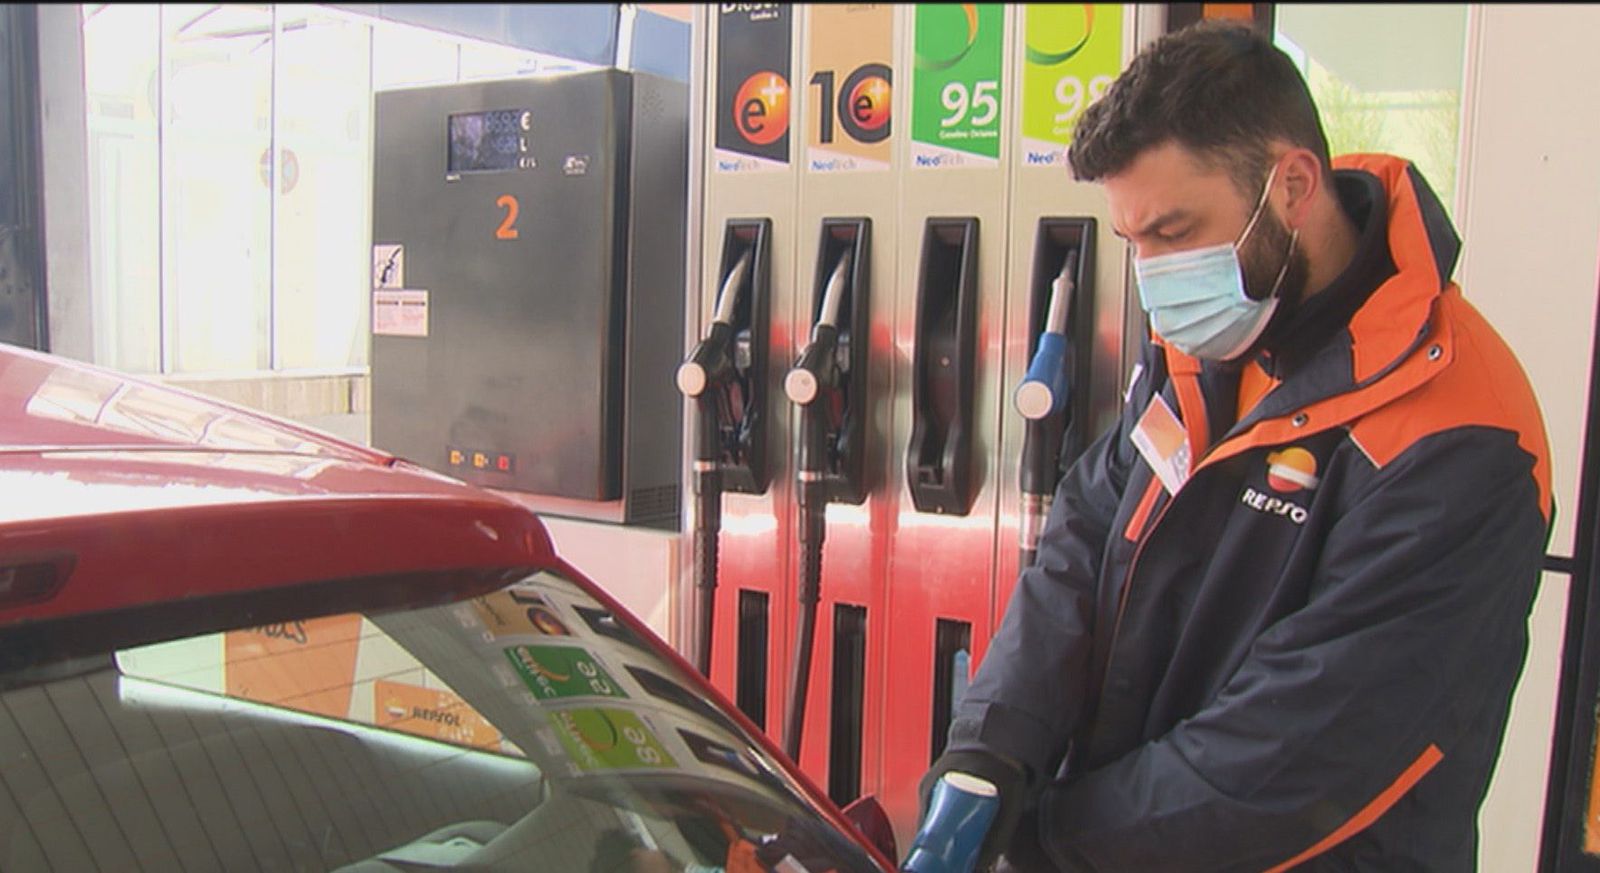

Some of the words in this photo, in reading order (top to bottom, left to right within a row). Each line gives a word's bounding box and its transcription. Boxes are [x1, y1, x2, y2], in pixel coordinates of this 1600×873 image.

[941, 81, 999, 127] 95
[520, 138, 528, 151] L
[496, 194, 519, 239] 2
[1242, 488, 1308, 524] REPSO
